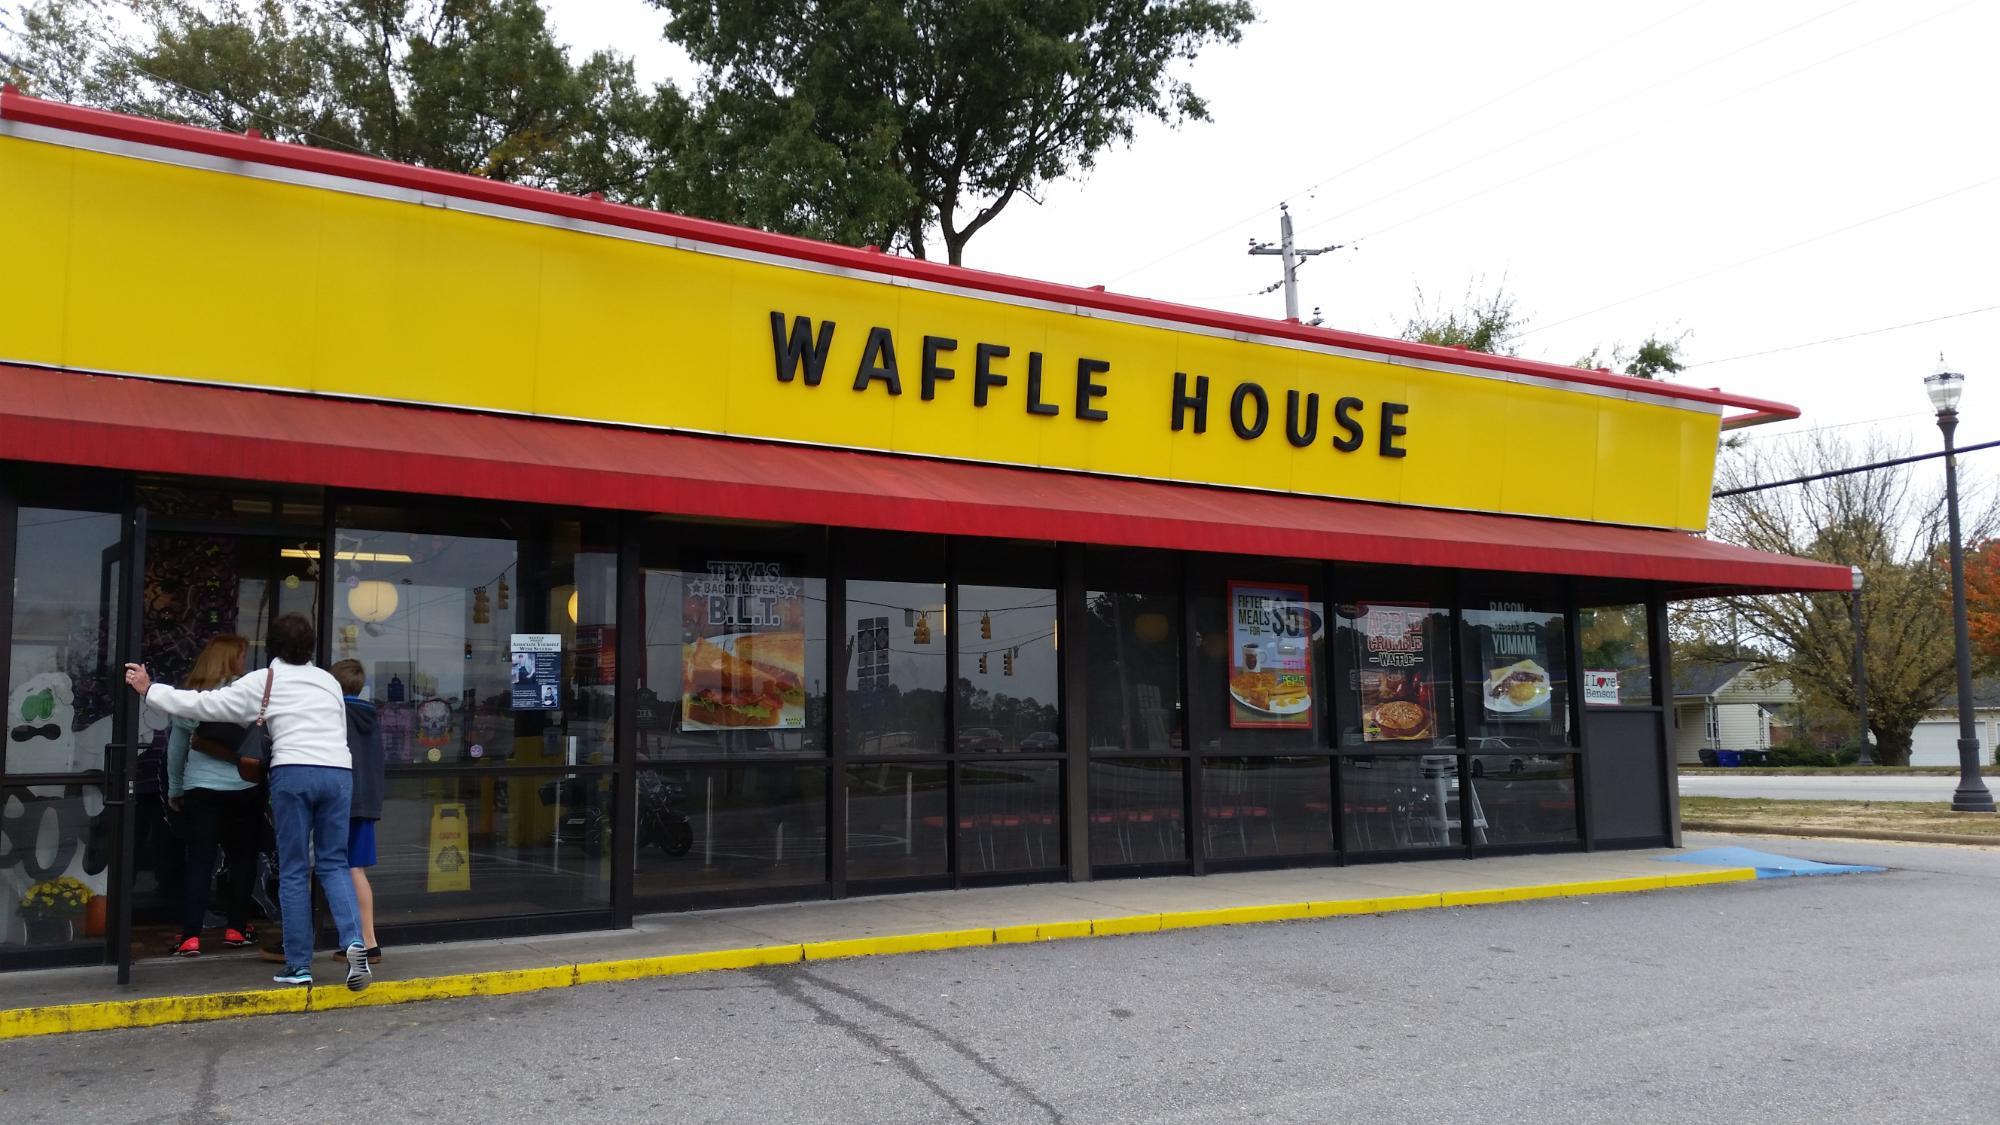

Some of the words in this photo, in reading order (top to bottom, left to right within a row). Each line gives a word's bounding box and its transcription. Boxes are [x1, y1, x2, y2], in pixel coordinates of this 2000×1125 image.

[770, 311, 1111, 421] WAFFLE
[1171, 372, 1408, 458] HOUSE
[707, 561, 781, 582] TEXAS
[704, 582, 738, 595] BACON
[742, 582, 785, 596] LOVER'S
[708, 595, 781, 625] B.L.T.
[1238, 594, 1270, 609] FIFTEEN
[1238, 608, 1270, 626] MEALS
[1272, 597, 1300, 636] $5
[1367, 635, 1424, 652] CRUMBLE
[1492, 634, 1537, 655] YUMMM
[1379, 651, 1415, 666] WAFFLE
[1586, 688, 1617, 699] Benson
